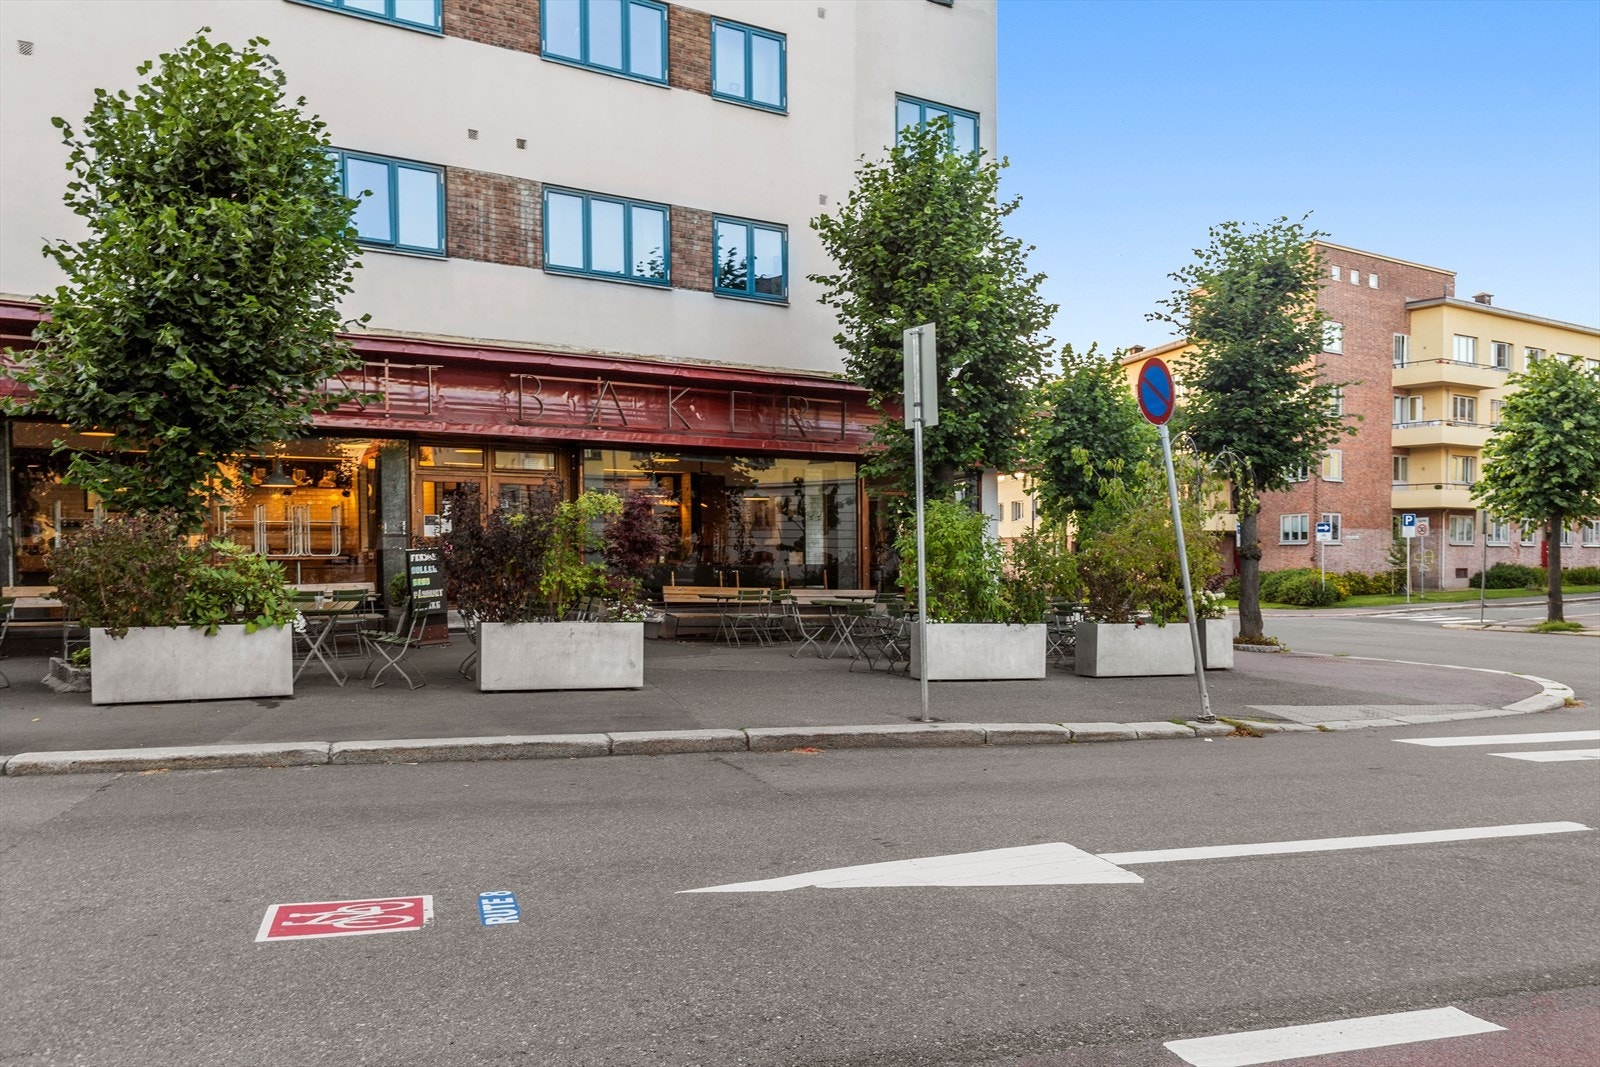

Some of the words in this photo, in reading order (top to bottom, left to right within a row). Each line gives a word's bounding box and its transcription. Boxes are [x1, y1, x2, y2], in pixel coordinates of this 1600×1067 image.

[518, 373, 847, 441] BAKERI
[1405, 515, 1413, 526] P
[481, 897, 520, 925] RUTE
